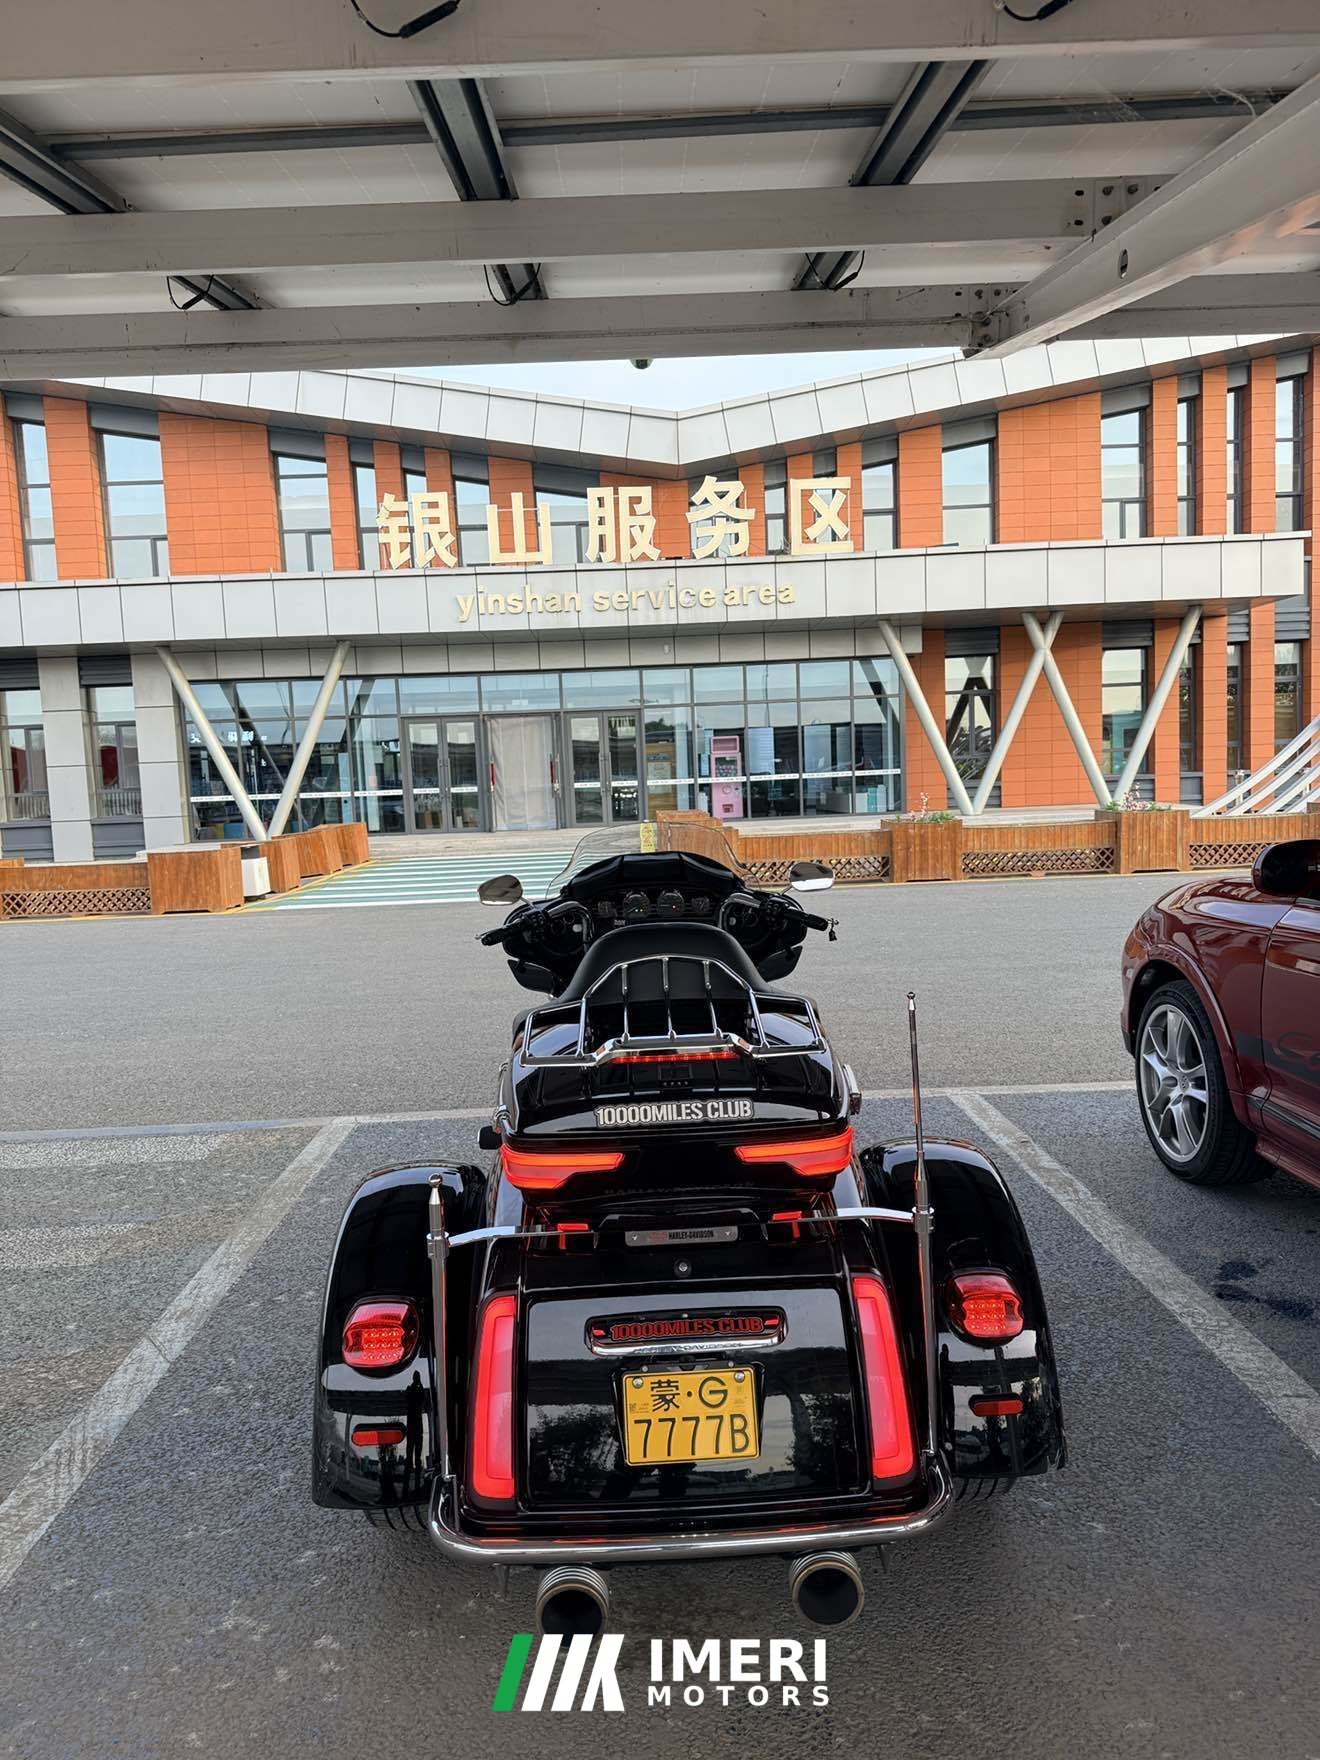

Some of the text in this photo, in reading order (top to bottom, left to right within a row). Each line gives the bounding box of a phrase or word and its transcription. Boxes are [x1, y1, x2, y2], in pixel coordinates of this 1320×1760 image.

[376, 475, 854, 569] 银山服务区
[456, 579, 796, 622] yinshan service area
[596, 1100, 751, 1125] 10000MILES CLUB
[611, 1317, 763, 1340] 10000MILES CLUB
[634, 1413, 749, 1458] 7777B
